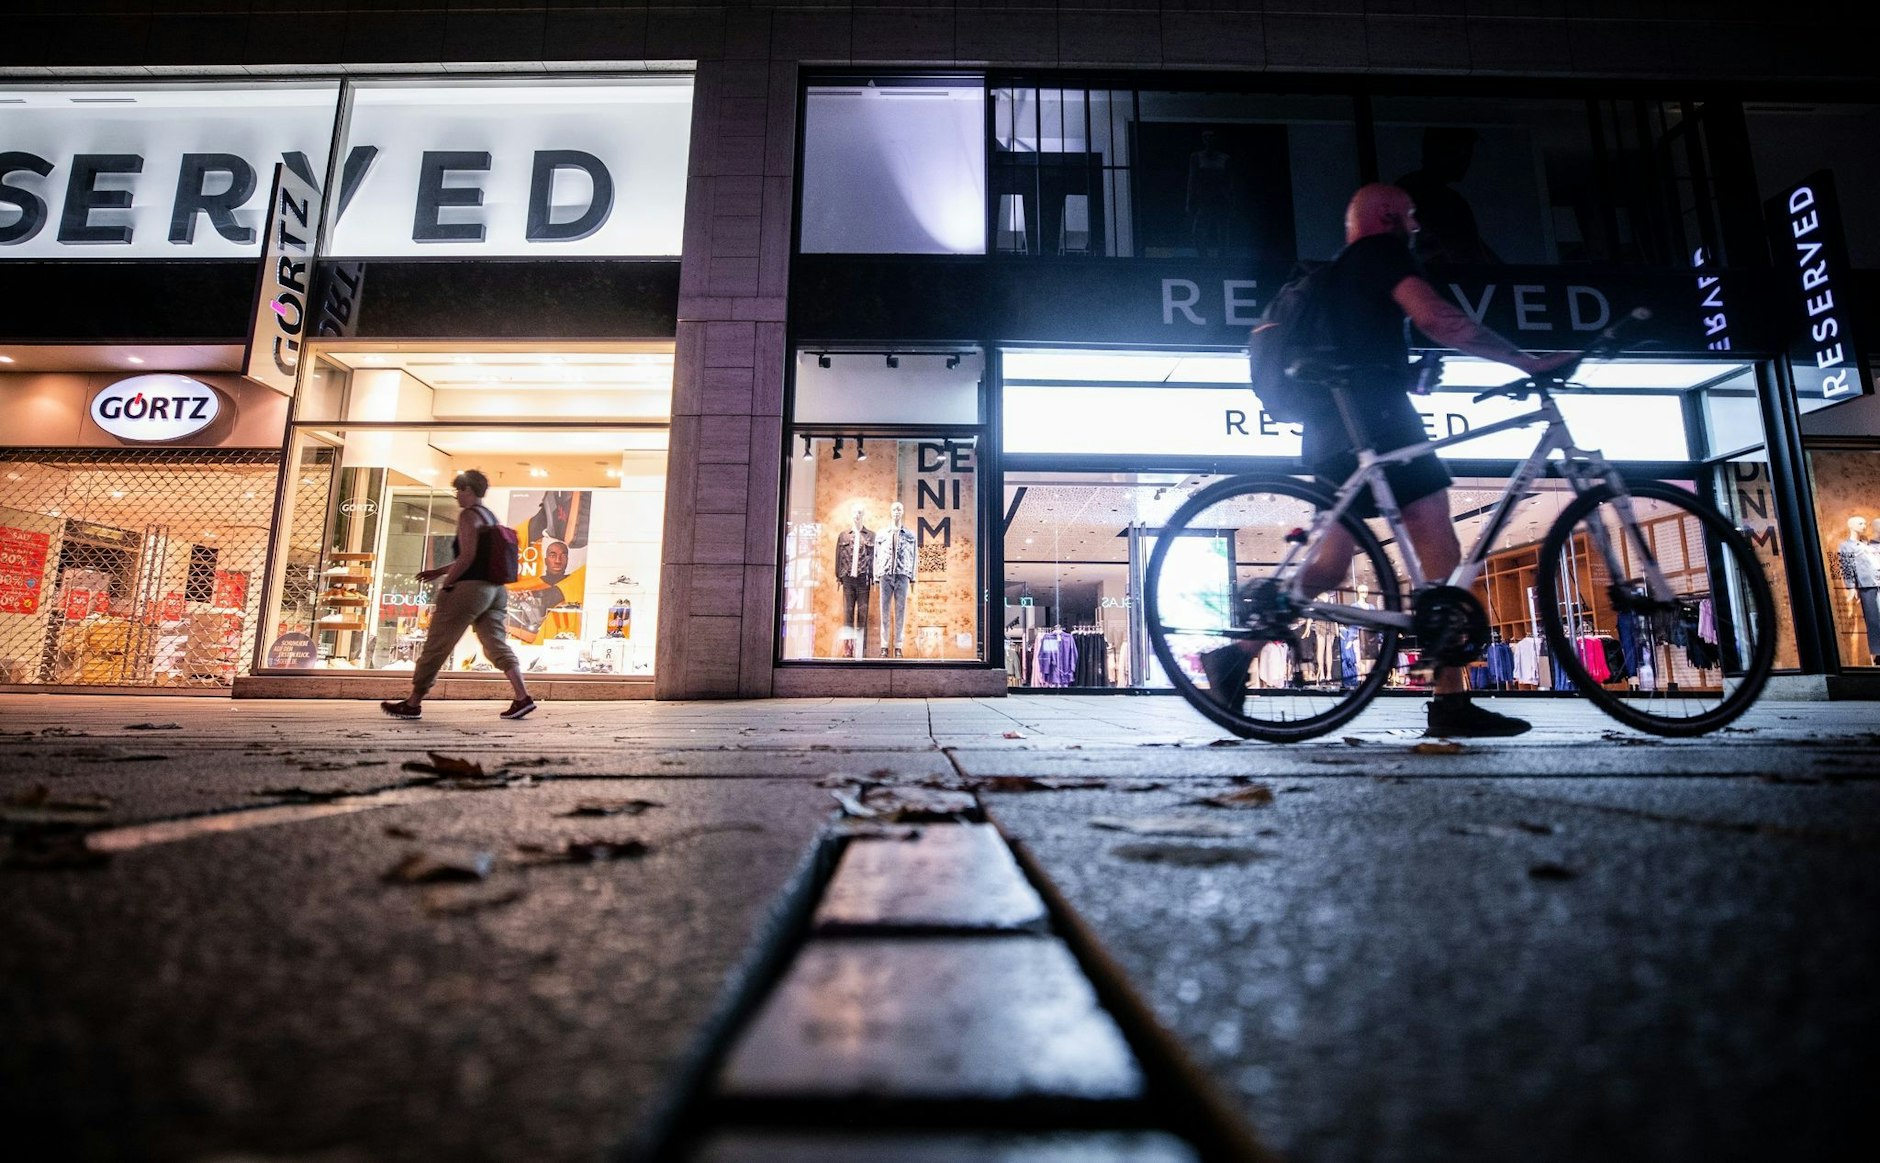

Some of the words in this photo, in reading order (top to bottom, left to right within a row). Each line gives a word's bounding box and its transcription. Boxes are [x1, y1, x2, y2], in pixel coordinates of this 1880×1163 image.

[1161, 278, 1612, 332] REVED
[1789, 186, 1850, 399] RESERVED
[918, 442, 975, 473] DE
[918, 479, 960, 510] NI
[917, 517, 951, 548] M
